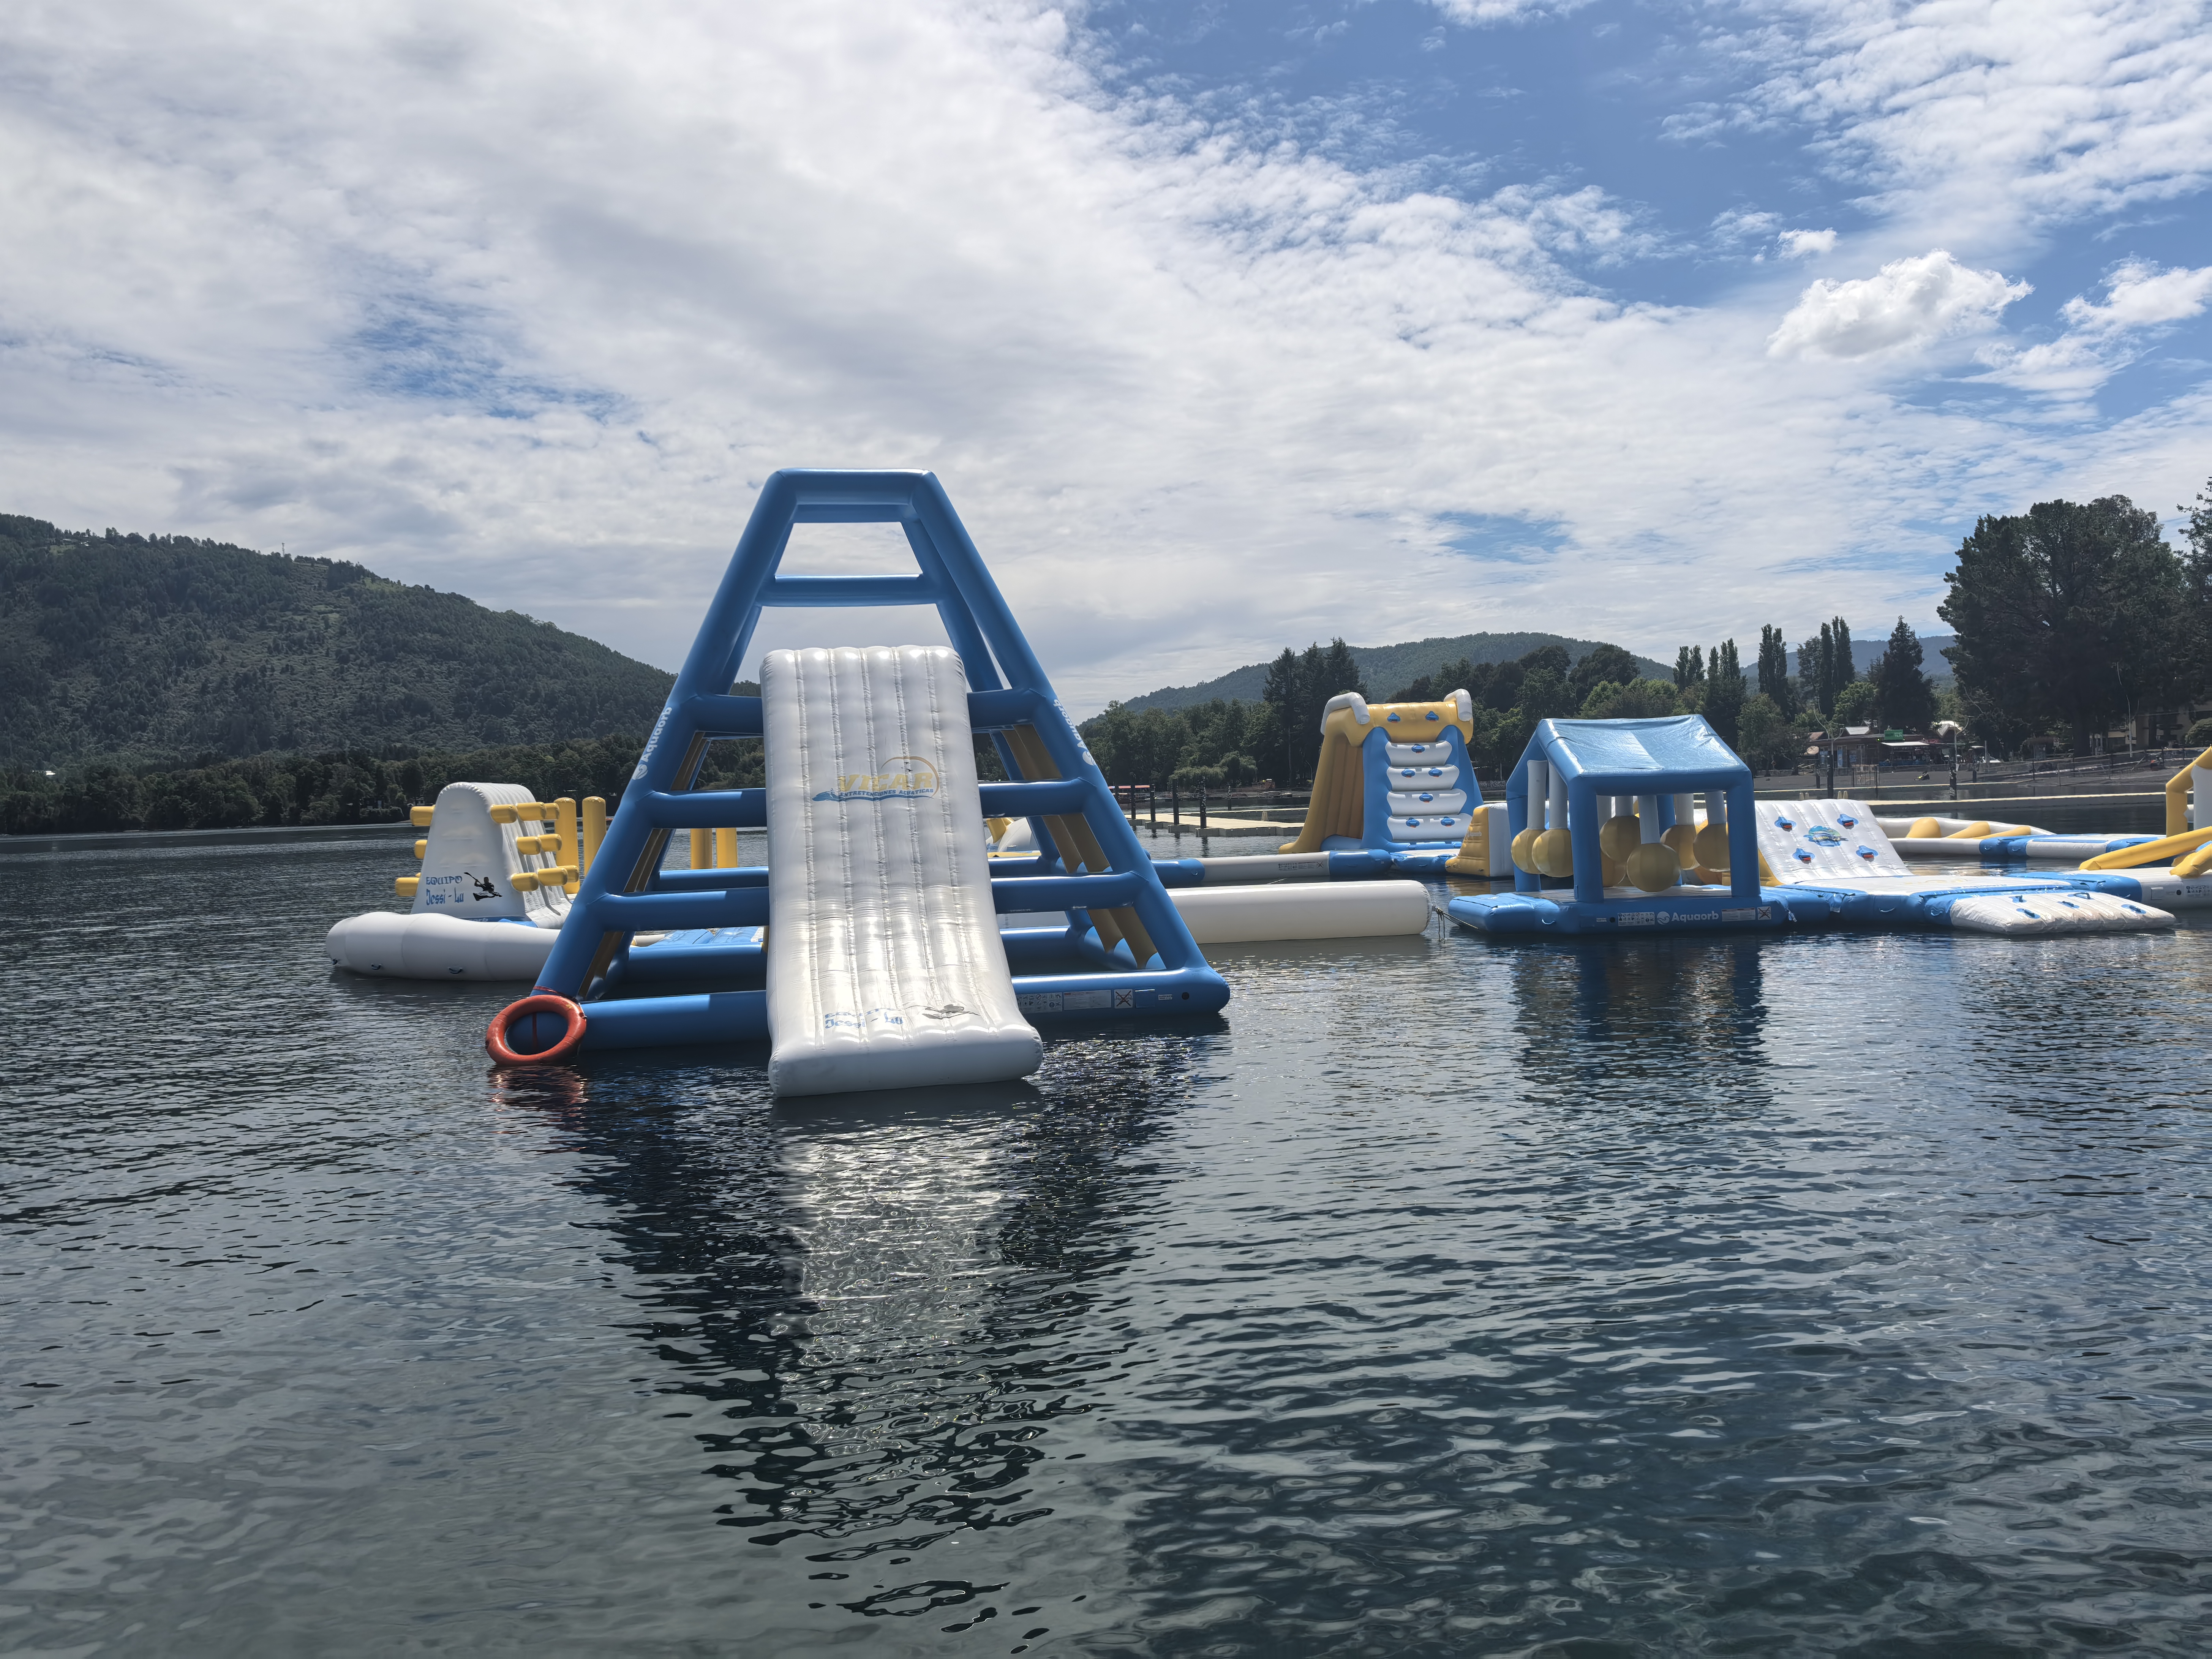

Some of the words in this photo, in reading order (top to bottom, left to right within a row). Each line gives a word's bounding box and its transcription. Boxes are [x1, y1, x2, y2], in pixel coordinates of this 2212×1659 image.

[640, 707, 672, 763] Aquaorb
[1053, 699, 1089, 751] Aquaorb
[838, 772, 933, 792] VICAR
[426, 875, 463, 885] EQUIPO
[1671, 911, 1719, 923] Aquaorb
